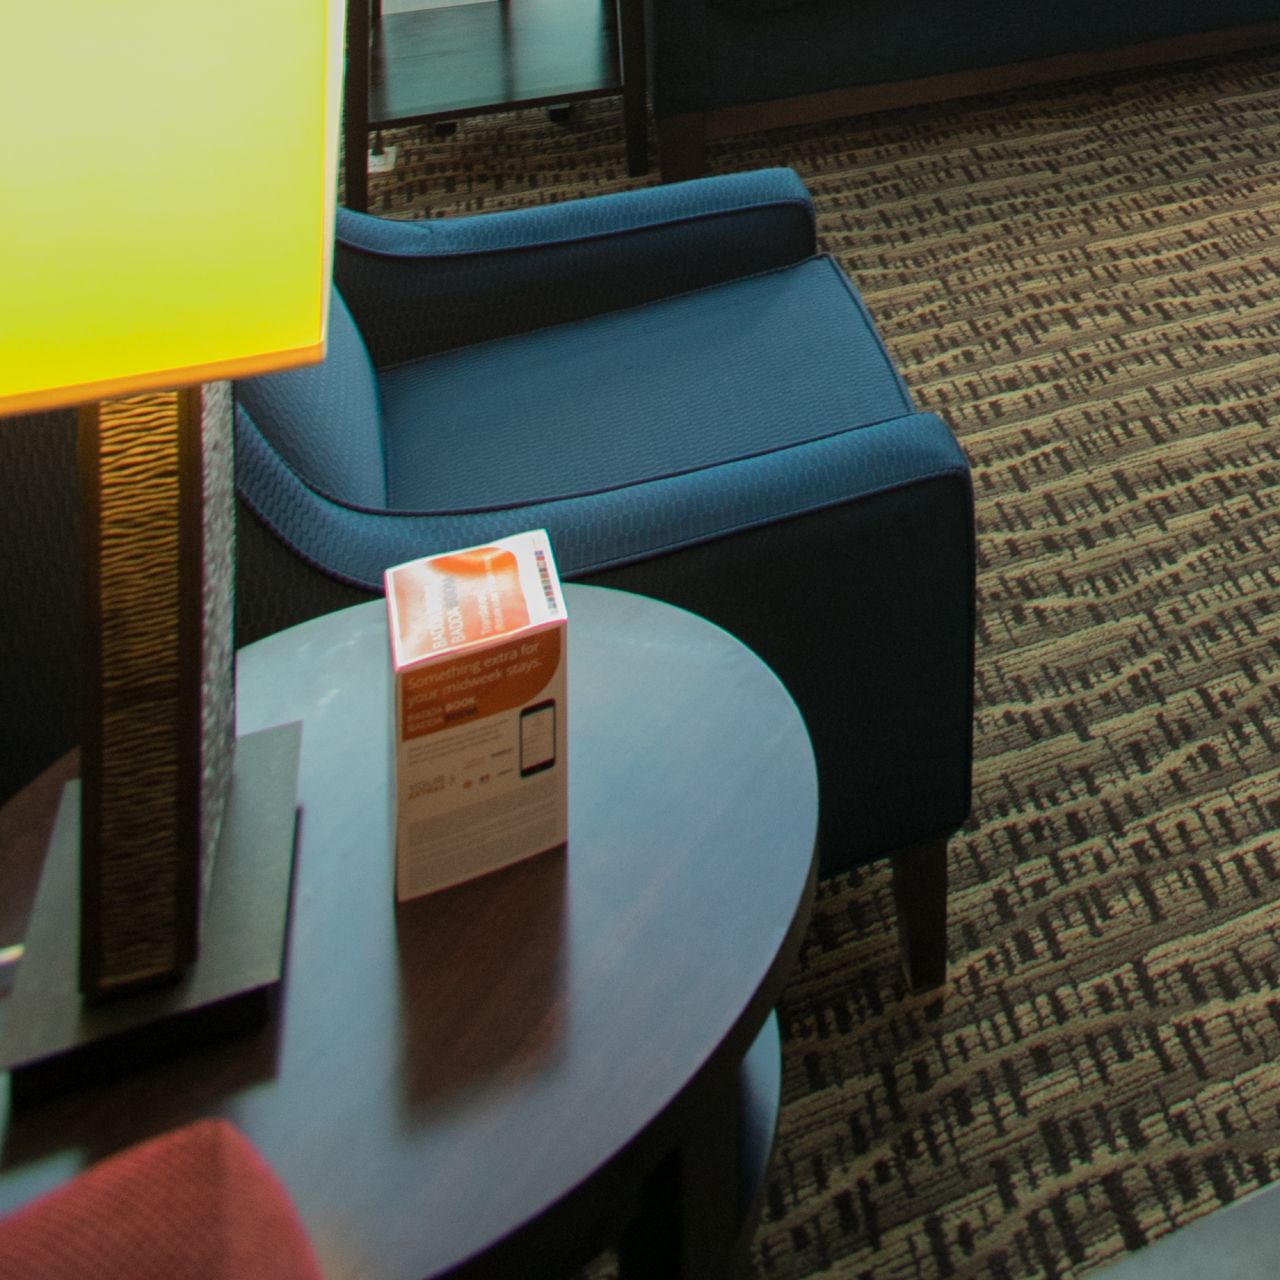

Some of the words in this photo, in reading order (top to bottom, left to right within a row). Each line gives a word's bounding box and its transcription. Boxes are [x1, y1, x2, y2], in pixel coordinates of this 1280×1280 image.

[407, 659, 481, 689] Something
[483, 647, 518, 668] extra
[521, 641, 541, 657] for
[406, 691, 438, 710] your
[442, 670, 503, 694] midweek
